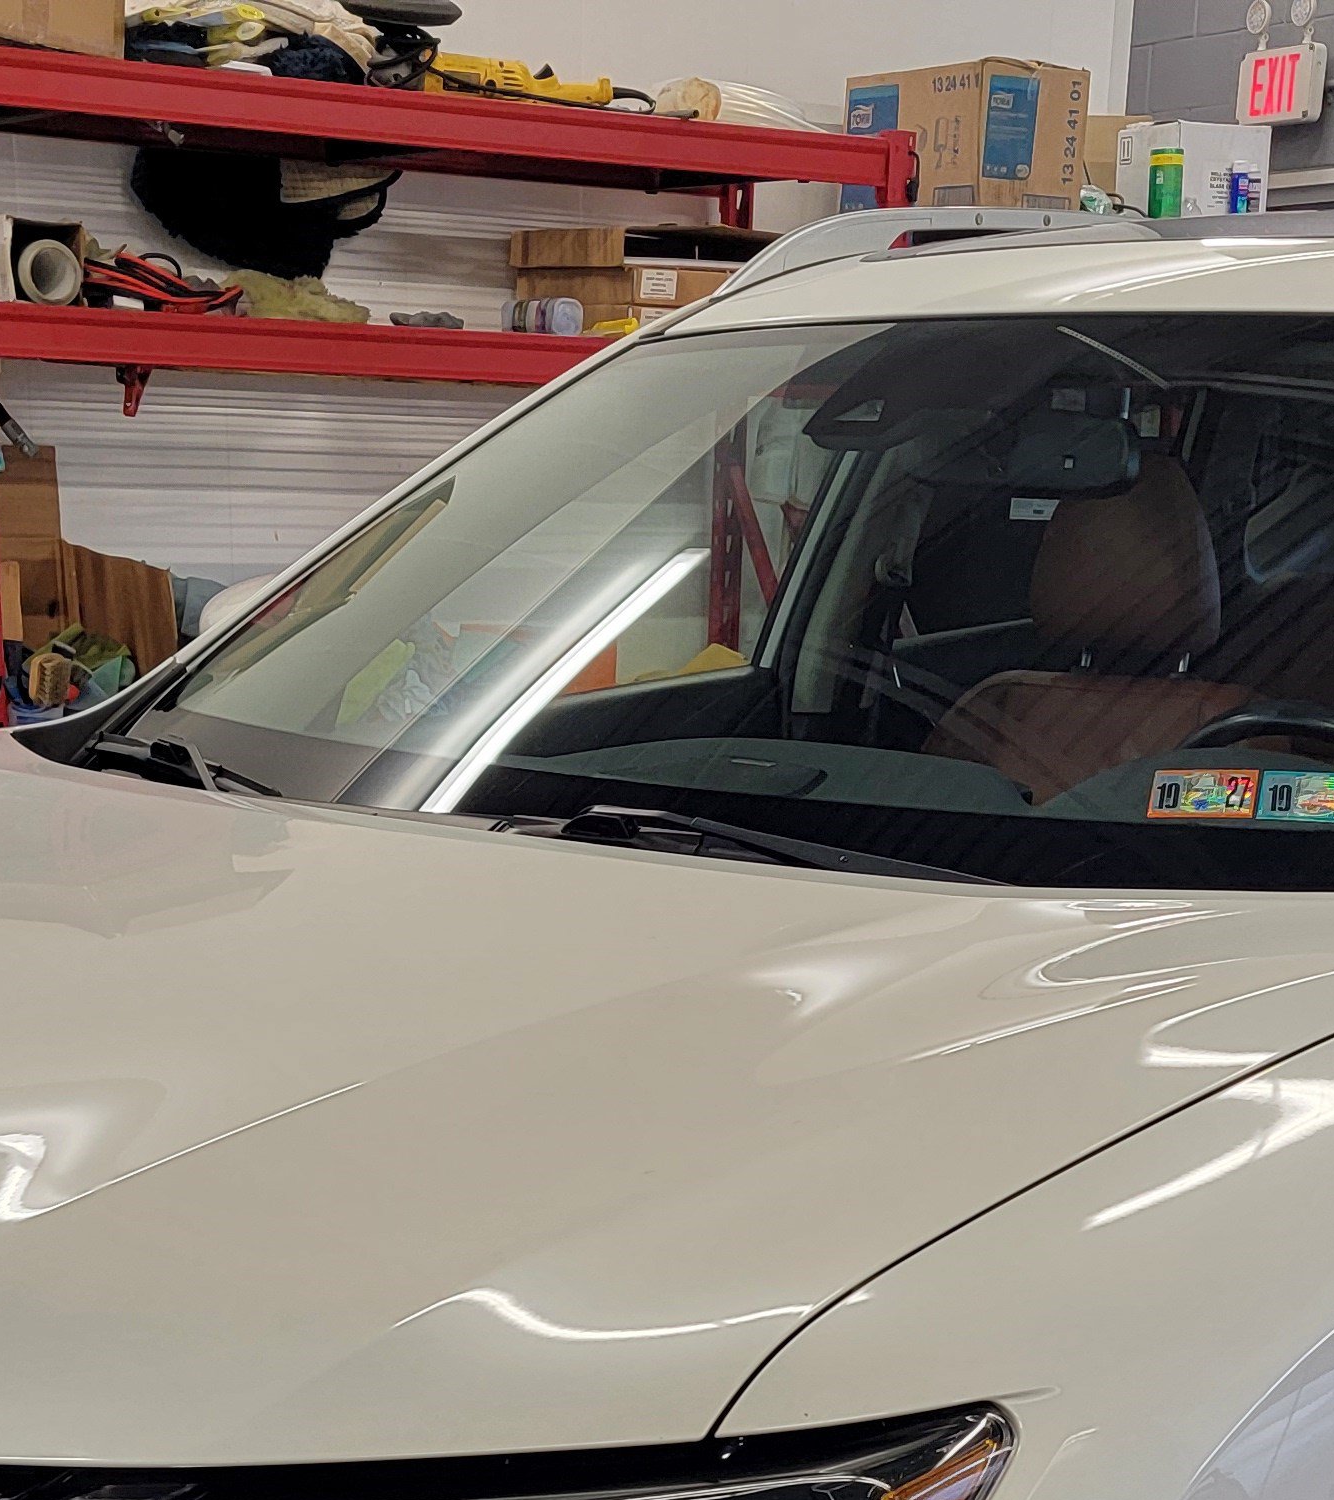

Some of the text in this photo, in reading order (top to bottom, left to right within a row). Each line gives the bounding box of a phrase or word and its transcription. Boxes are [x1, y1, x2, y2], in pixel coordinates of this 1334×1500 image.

[1249, 53, 1301, 117] EXIT
[1062, 80, 1082, 184] 13 24 41 01
[1225, 776, 1251, 811] 27
